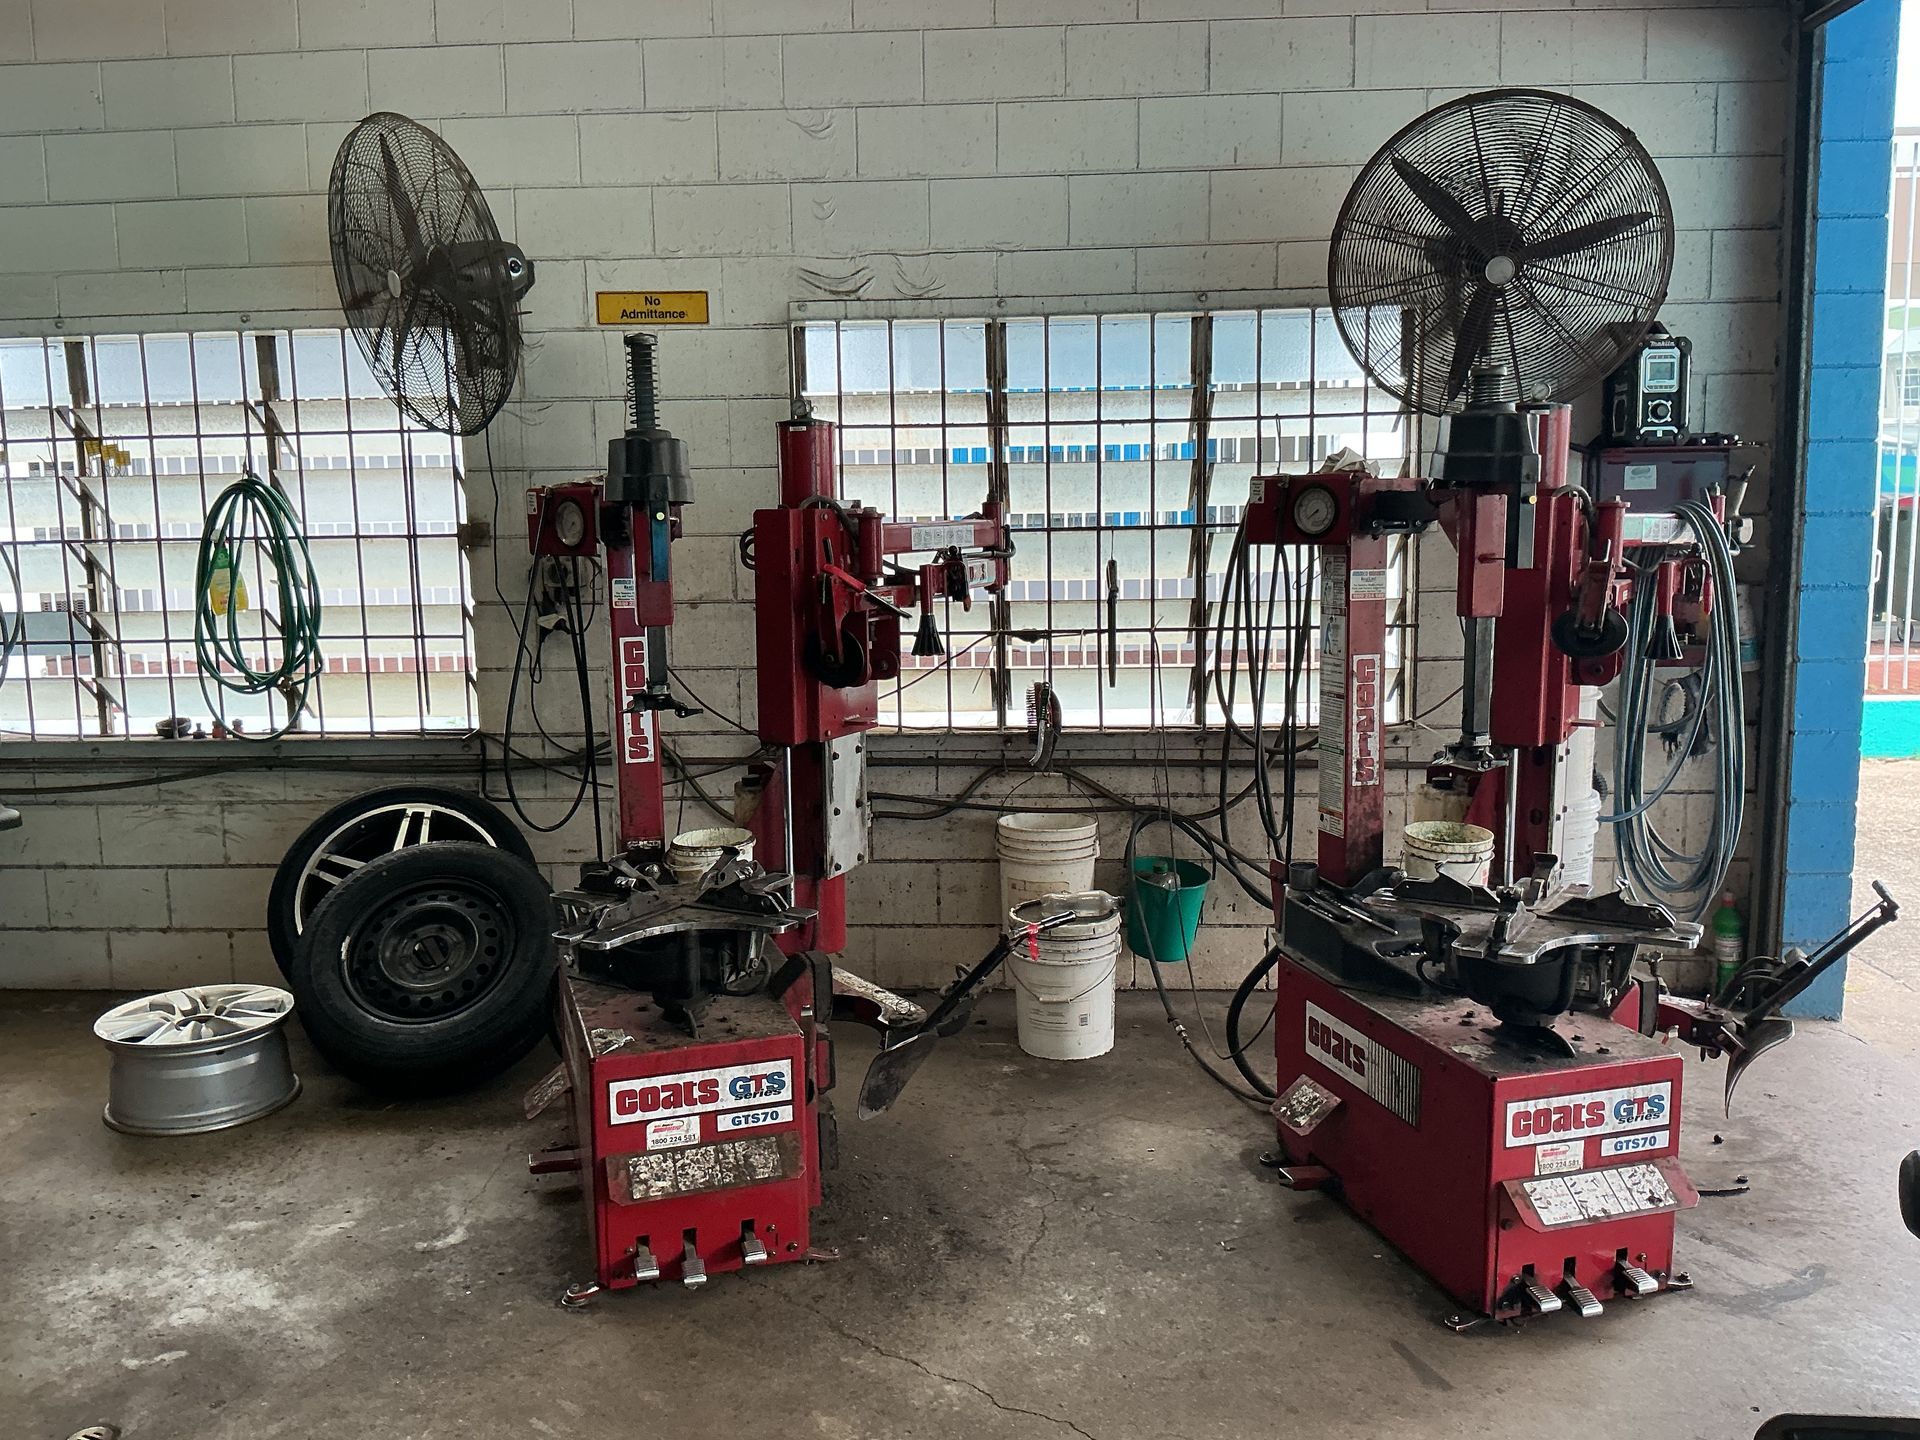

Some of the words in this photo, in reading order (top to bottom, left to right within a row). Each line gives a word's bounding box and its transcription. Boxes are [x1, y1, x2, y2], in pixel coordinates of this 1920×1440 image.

[644, 296, 661, 306] No
[620, 309, 686, 319] Admittance
[1308, 1015, 1366, 1078] coats
[615, 1077, 720, 1116] coats
[728, 1071, 787, 1099] GTS
[734, 1087, 782, 1102] series
[731, 1110, 780, 1127] GTS70
[1511, 1100, 1606, 1138] coats
[1613, 1094, 1666, 1121] GTS
[1617, 1108, 1661, 1125] series
[651, 1137, 668, 1145] 1800
[669, 1135, 682, 1143] 224
[1613, 1135, 1657, 1152] GTS70
[1568, 1159, 1580, 1167] 581
